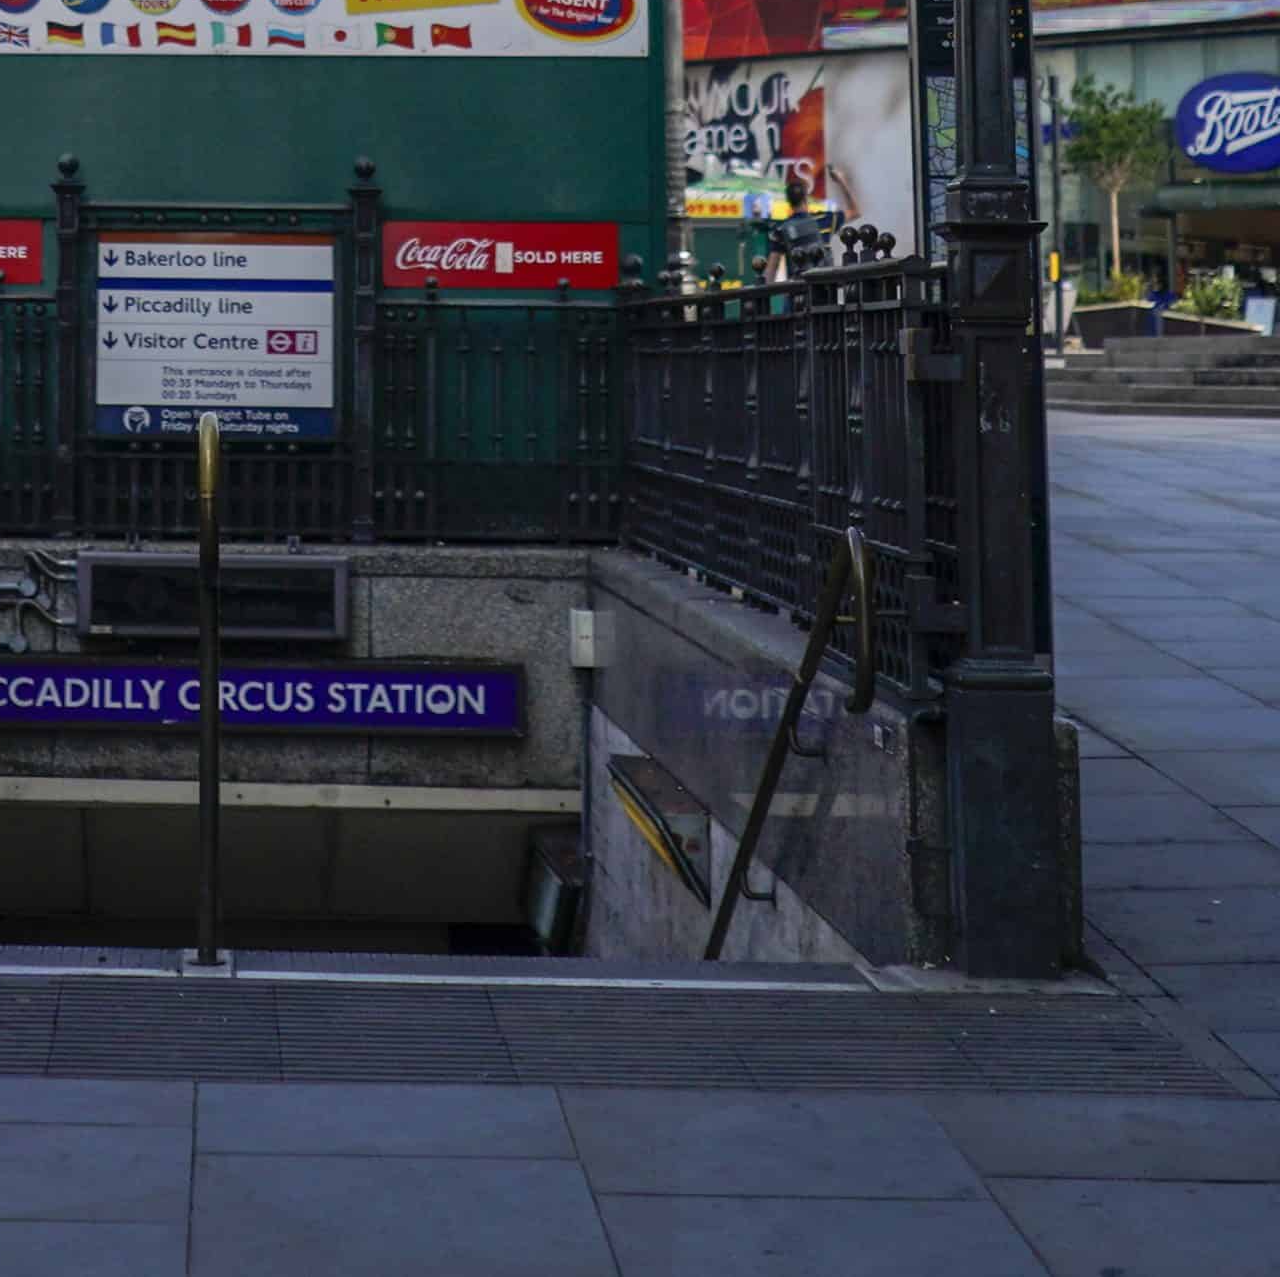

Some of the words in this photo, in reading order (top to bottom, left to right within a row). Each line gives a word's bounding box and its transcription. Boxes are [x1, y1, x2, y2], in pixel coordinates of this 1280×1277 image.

[139, 0, 170, 10] TOURS
[124, 249, 207, 268] Bakerloo
[212, 250, 248, 268] line
[395, 237, 494, 271] Coca-Cola
[513, 250, 556, 265] SOLD
[560, 250, 604, 265] HERE
[124, 295, 212, 317] Piccadilly
[218, 297, 254, 314] line
[124, 332, 187, 350] Visitor
[193, 332, 260, 351] Centre
[161, 365, 184, 378] This
[186, 367, 232, 379] entrance
[235, 368, 245, 379] is
[248, 367, 282, 379] closed
[285, 368, 312, 380] after
[194, 378, 241, 392] Mondays
[244, 379, 257, 389] to
[259, 379, 313, 393] Thursdays
[194, 389, 238, 404] Sundays
[161, 409, 192, 421] Open
[218, 410, 242, 422] ight
[246, 410, 271, 421] Tube
[273, 412, 289, 421] on
[266, 422, 300, 435] nights
[178, 679, 314, 713] CRCUS
[327, 682, 486, 715] STATION
